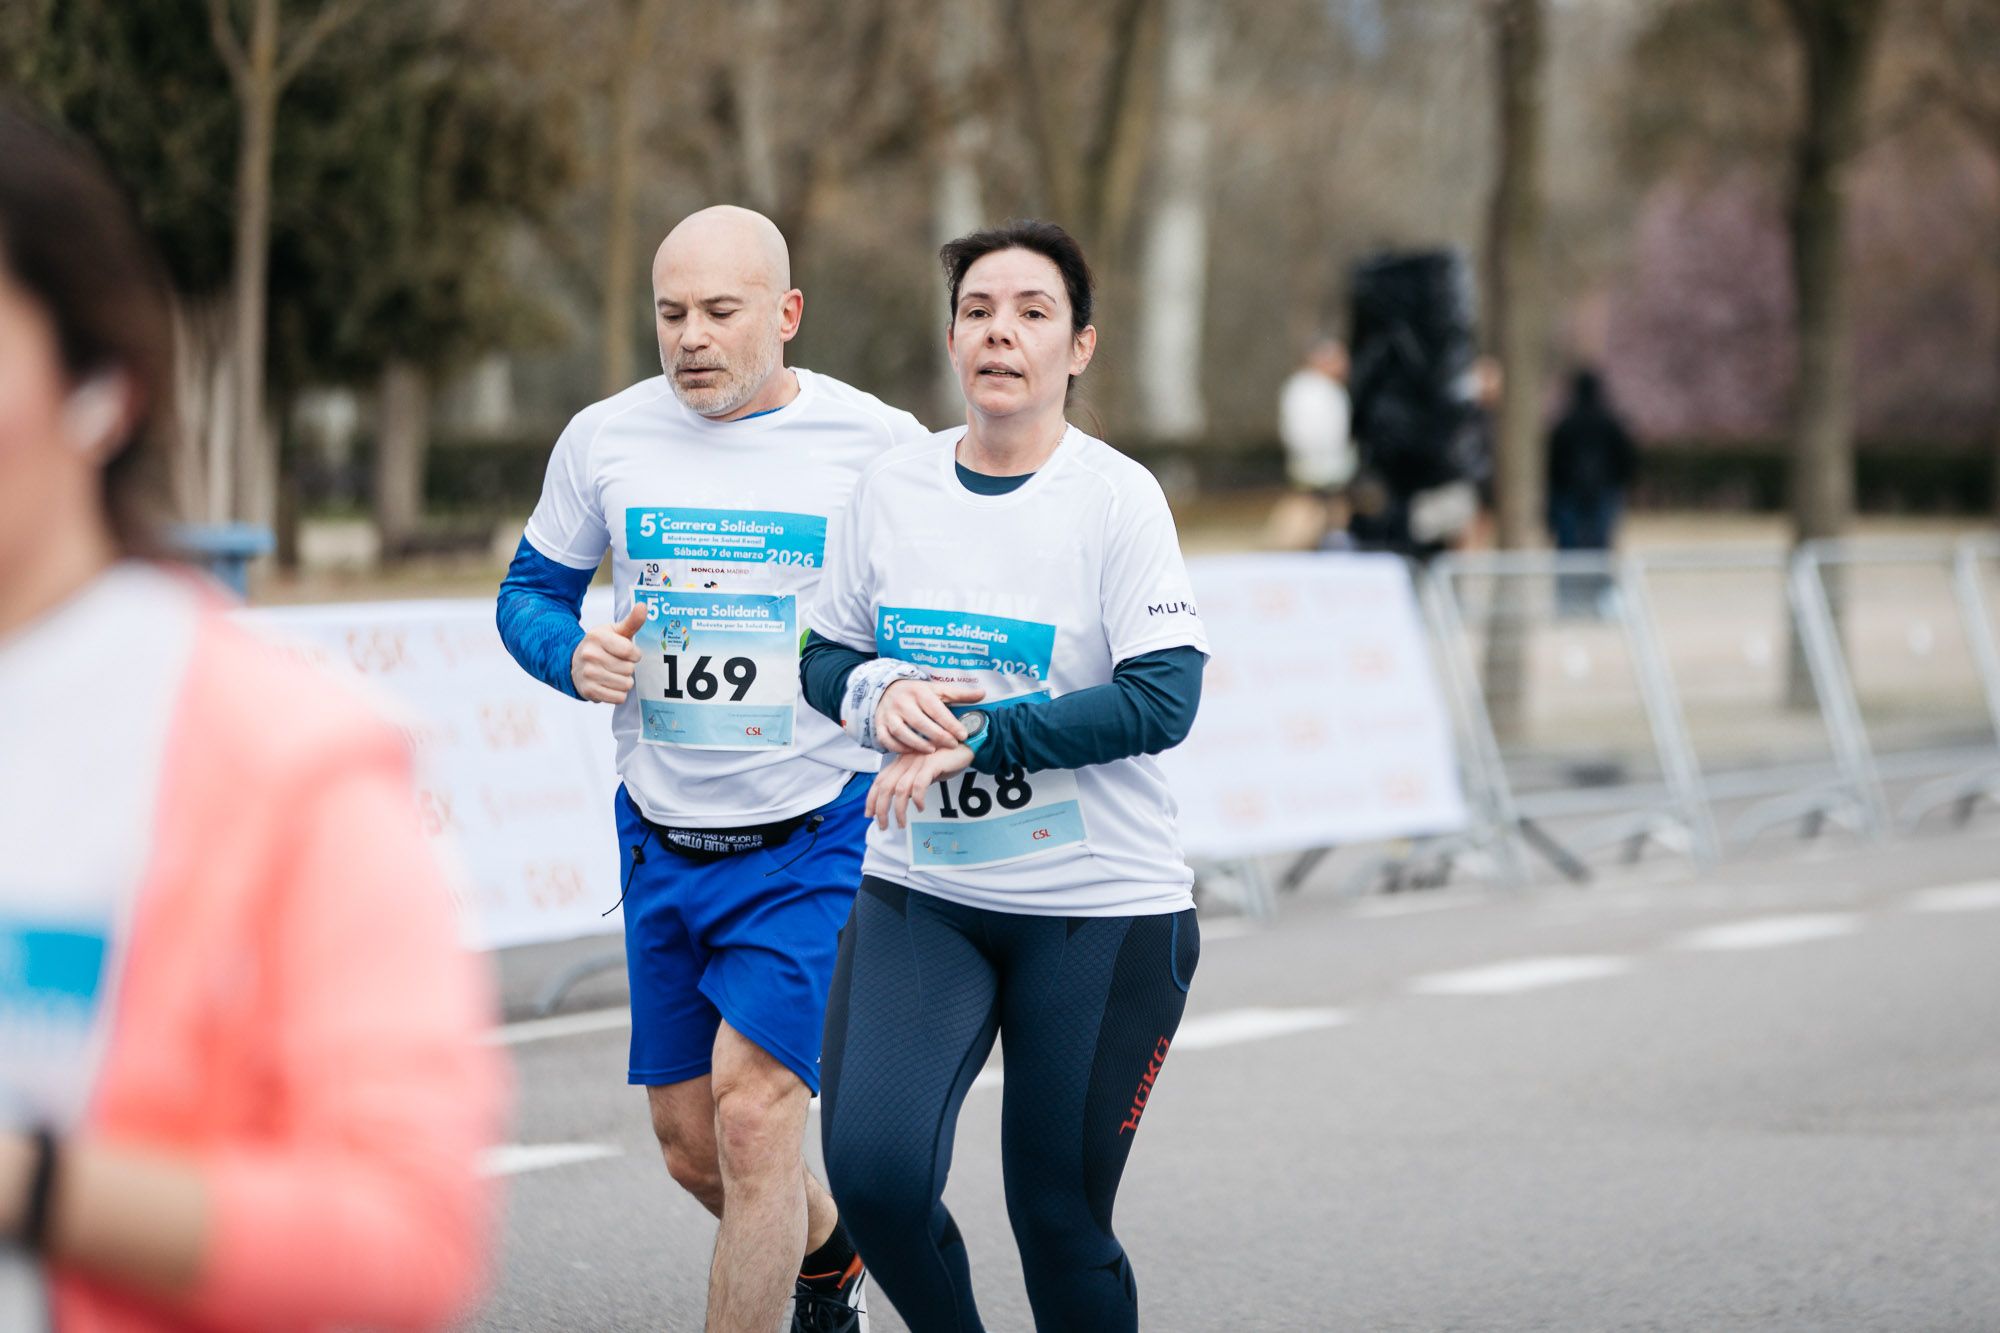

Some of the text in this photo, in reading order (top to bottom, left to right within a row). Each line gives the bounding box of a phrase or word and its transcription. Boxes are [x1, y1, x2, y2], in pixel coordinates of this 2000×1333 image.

[660, 517, 716, 532] Carrera
[720, 519, 785, 535] Solidaria
[674, 547, 814, 567] Sábado 7 de marzo 2026
[661, 602, 708, 617] Carrera
[711, 604, 770, 618] Solidaria
[896, 620, 944, 636] Carrera
[947, 623, 1009, 644] Solidaria
[663, 654, 757, 701] 169
[940, 655, 946, 664] 7
[948, 656, 959, 666] de
[991, 658, 1040, 681] 2026
[745, 726, 763, 736] CSL
[940, 763, 1033, 819] 168
[1032, 828, 1051, 840] CSL
